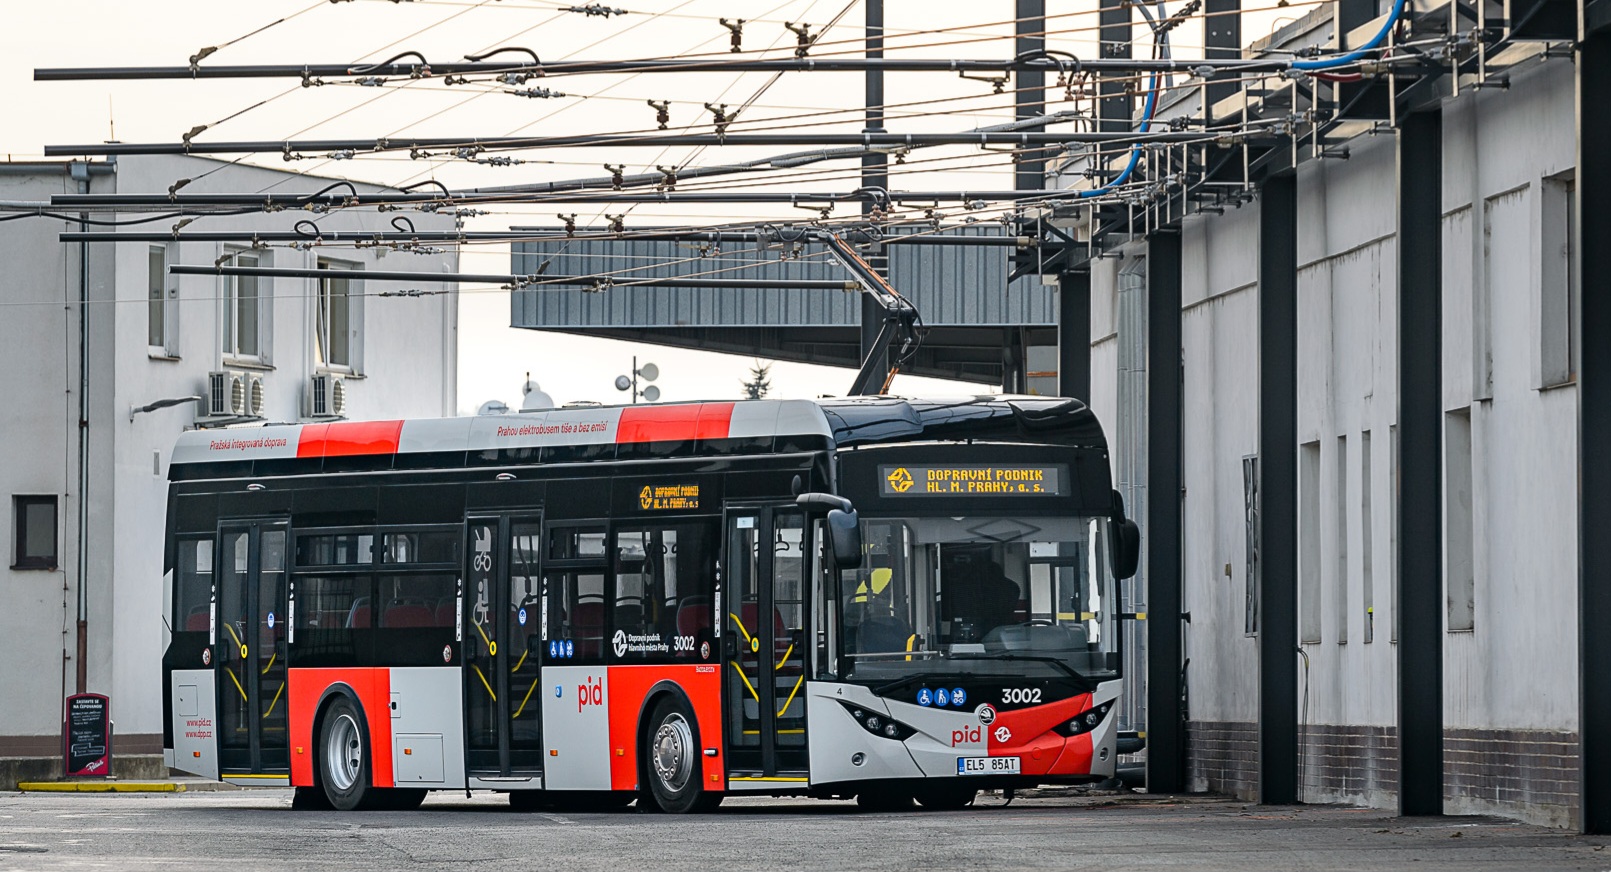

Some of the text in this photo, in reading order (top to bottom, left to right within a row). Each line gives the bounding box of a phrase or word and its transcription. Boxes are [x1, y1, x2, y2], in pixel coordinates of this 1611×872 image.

[497, 420, 608, 437] Prahou elektrobusem tiše a bez emisí
[210, 437, 286, 451] Pražská integrovaná doprava
[927, 468, 1043, 481] DOPRAVNÍ PODNIK
[926, 482, 1045, 493] HL. M. PRAHY, a. s.
[647, 633, 660, 644] podnik
[674, 636, 694, 650] 3002
[658, 643, 670, 653] Prahy
[578, 676, 602, 713] pid
[836, 688, 842, 696] 4
[1002, 688, 1042, 704] 3002
[952, 725, 981, 748] pid
[966, 760, 984, 770] EL5
[992, 758, 1016, 770] 85AT
